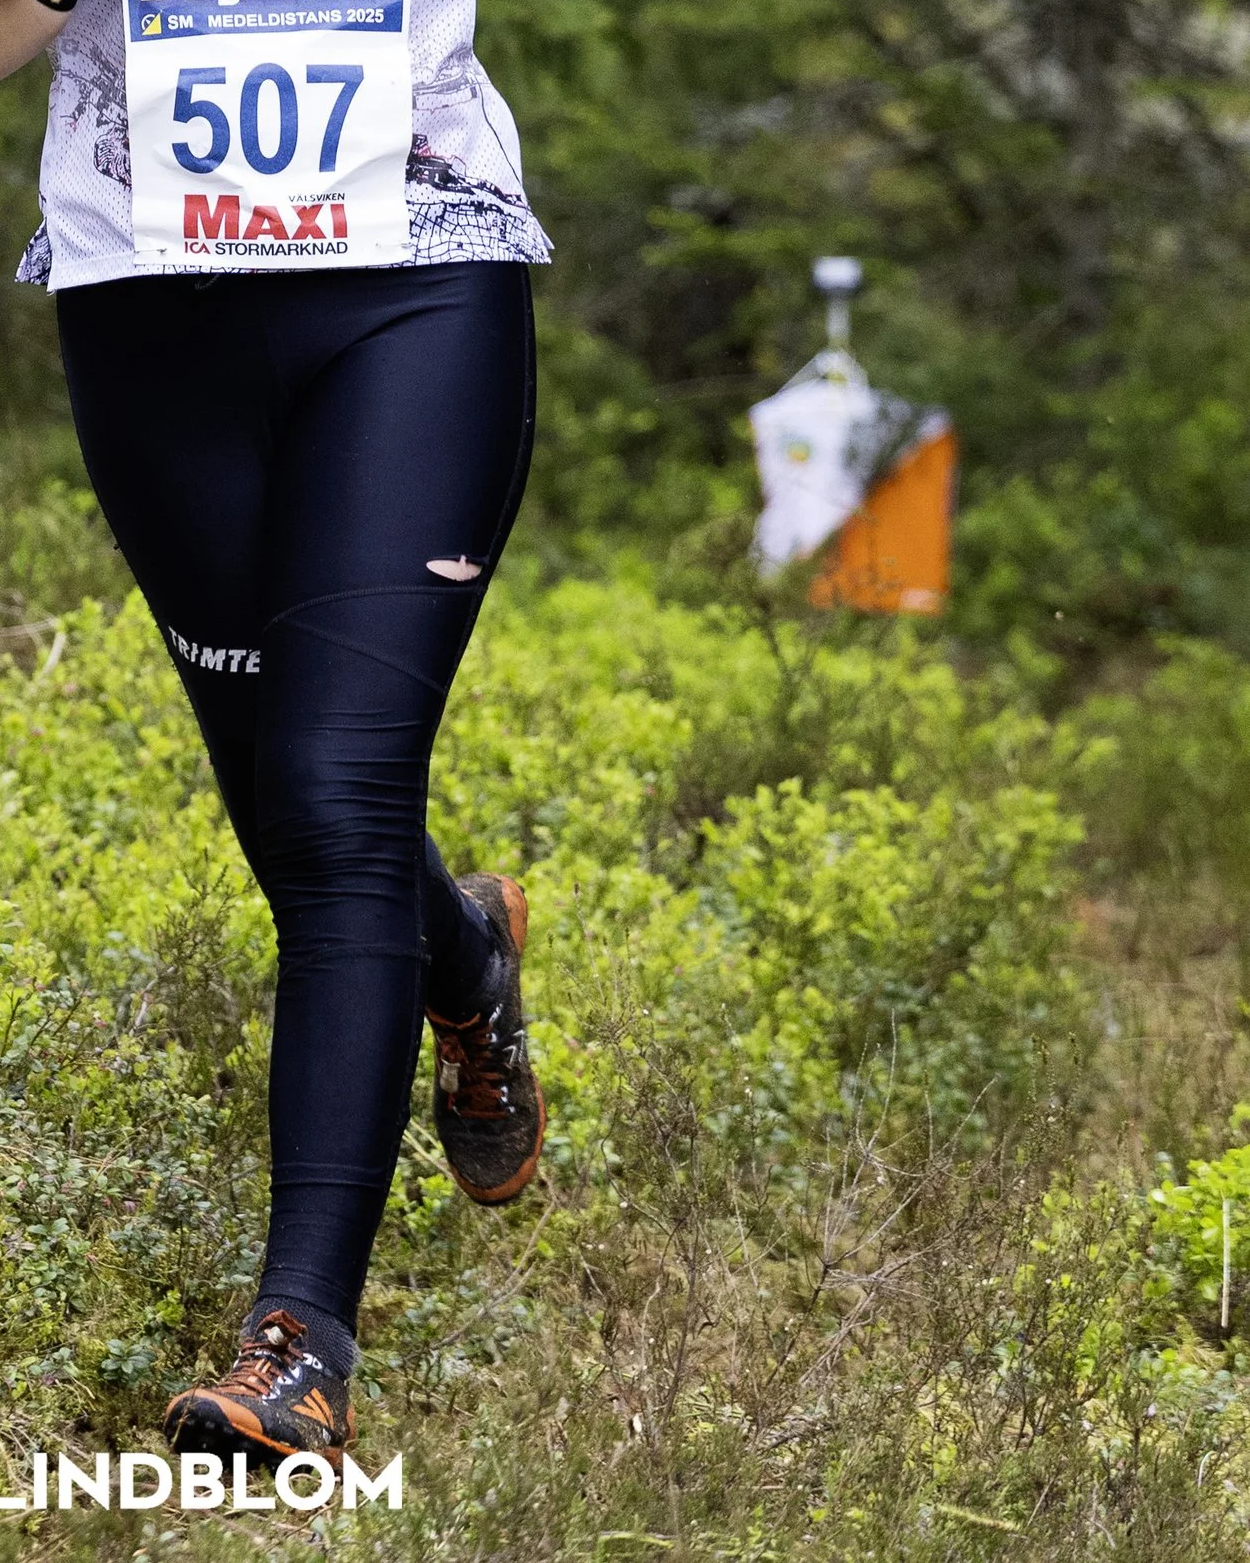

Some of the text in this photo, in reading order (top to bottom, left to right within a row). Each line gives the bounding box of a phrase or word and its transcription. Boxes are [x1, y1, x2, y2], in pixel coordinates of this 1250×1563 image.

[167, 8, 385, 30] SM MEDELDISTANS 2025
[171, 62, 365, 176] 507
[183, 194, 348, 241] MAXI
[184, 241, 349, 256] ICA STORMARKNAD
